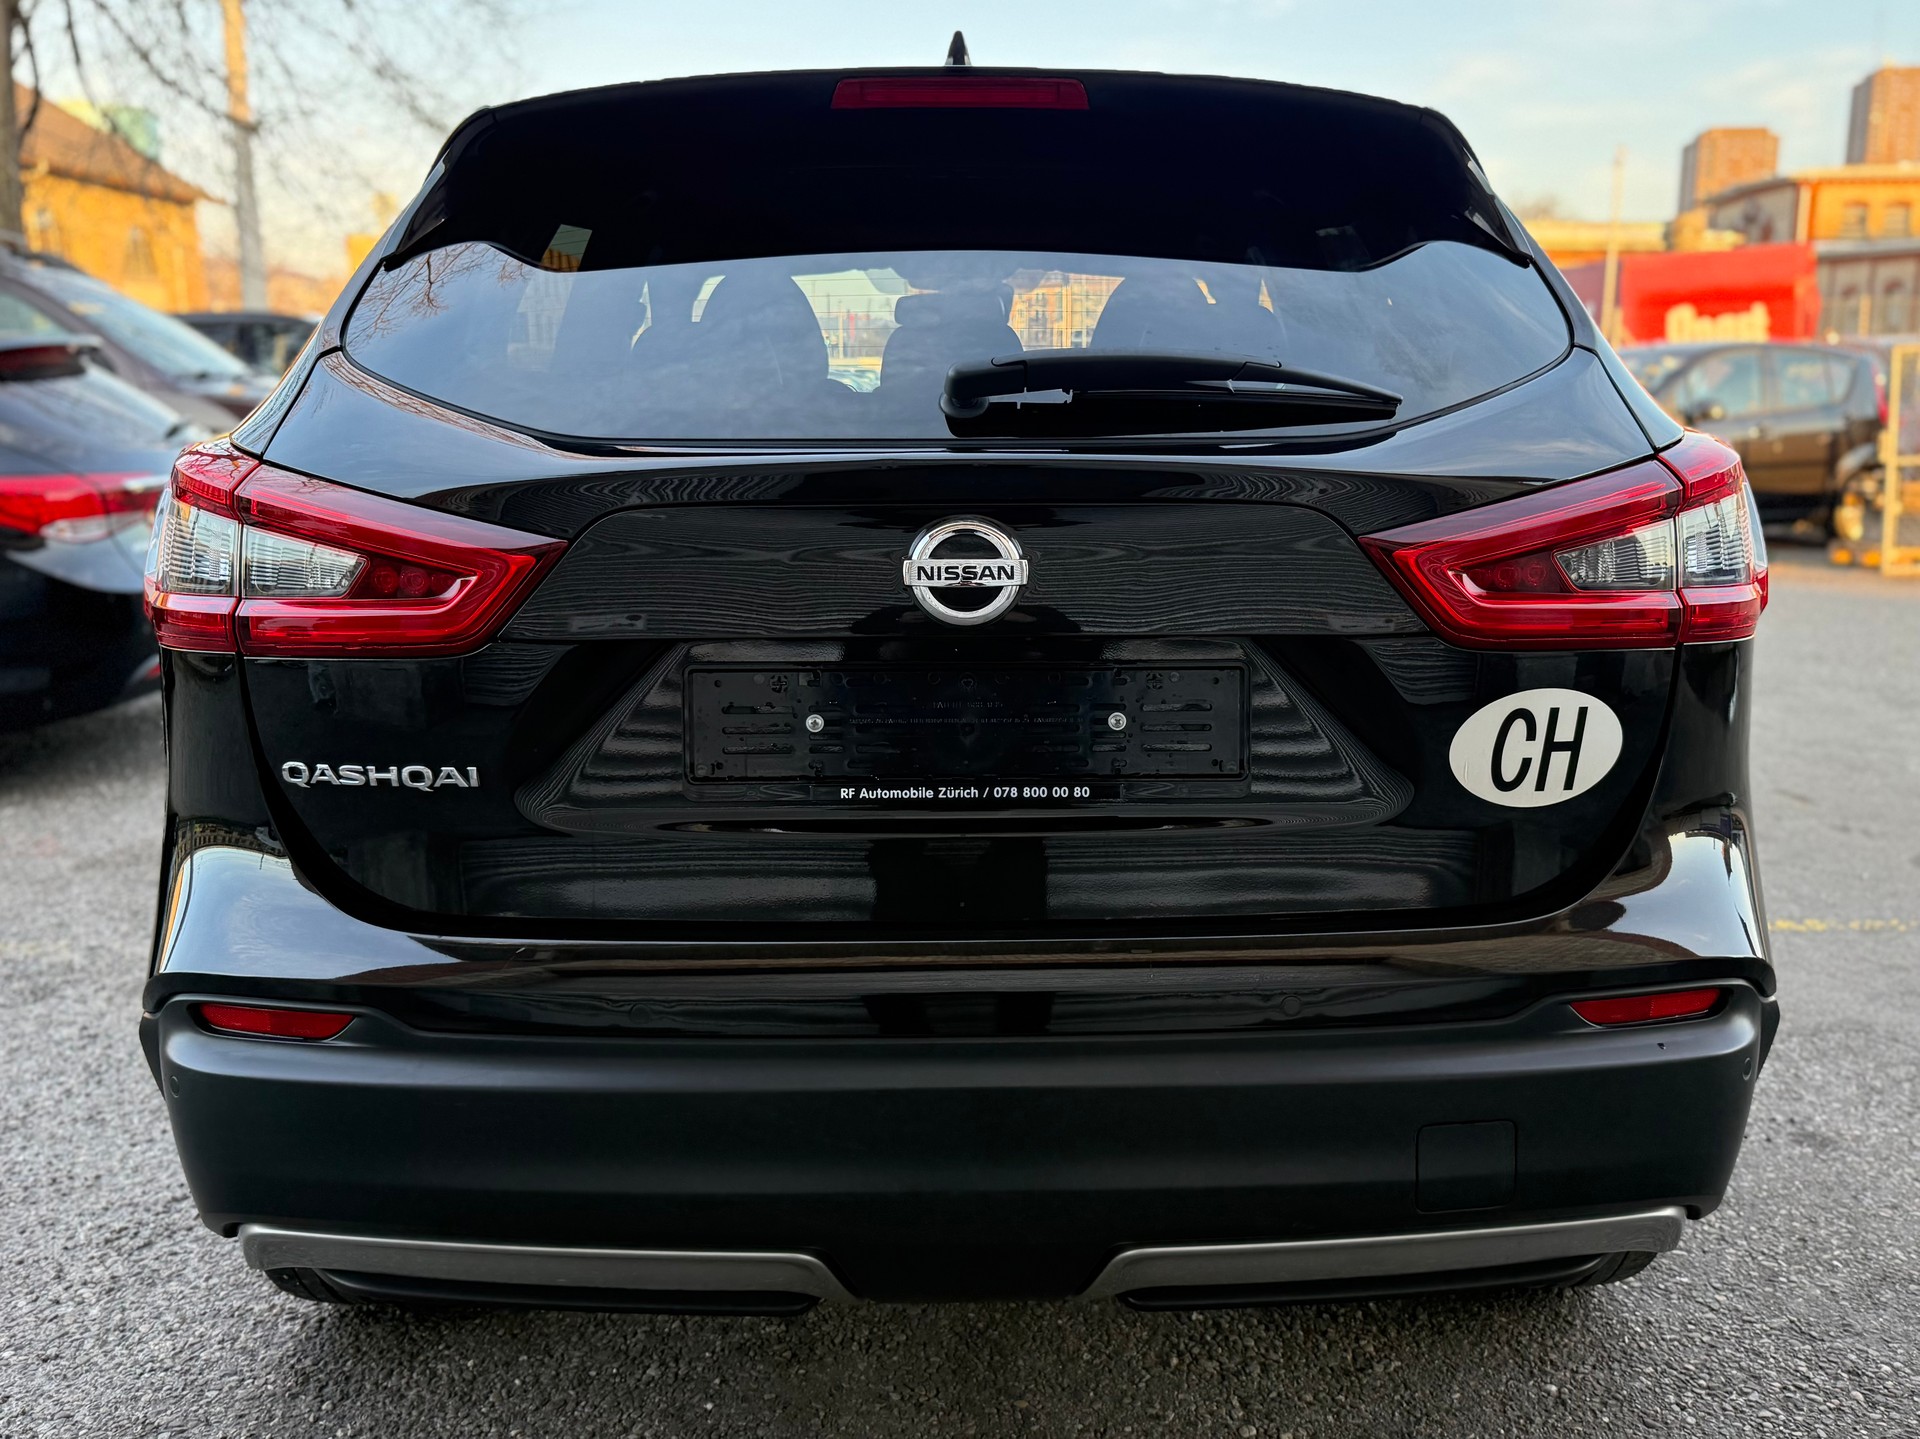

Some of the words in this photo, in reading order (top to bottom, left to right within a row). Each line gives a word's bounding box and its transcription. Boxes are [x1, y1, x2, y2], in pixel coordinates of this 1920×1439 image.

[917, 565, 1015, 581] NISSAN
[1490, 706, 1588, 792] CH
[281, 761, 480, 792] QASHQAI
[840, 787, 856, 799] RF
[859, 787, 934, 799] Automobile
[938, 787, 979, 799] Zürich
[983, 787, 989, 798] /
[993, 786, 1018, 798] 078
[1022, 786, 1048, 798] 800
[1052, 786, 1069, 798] 00
[1073, 786, 1090, 798] 80
